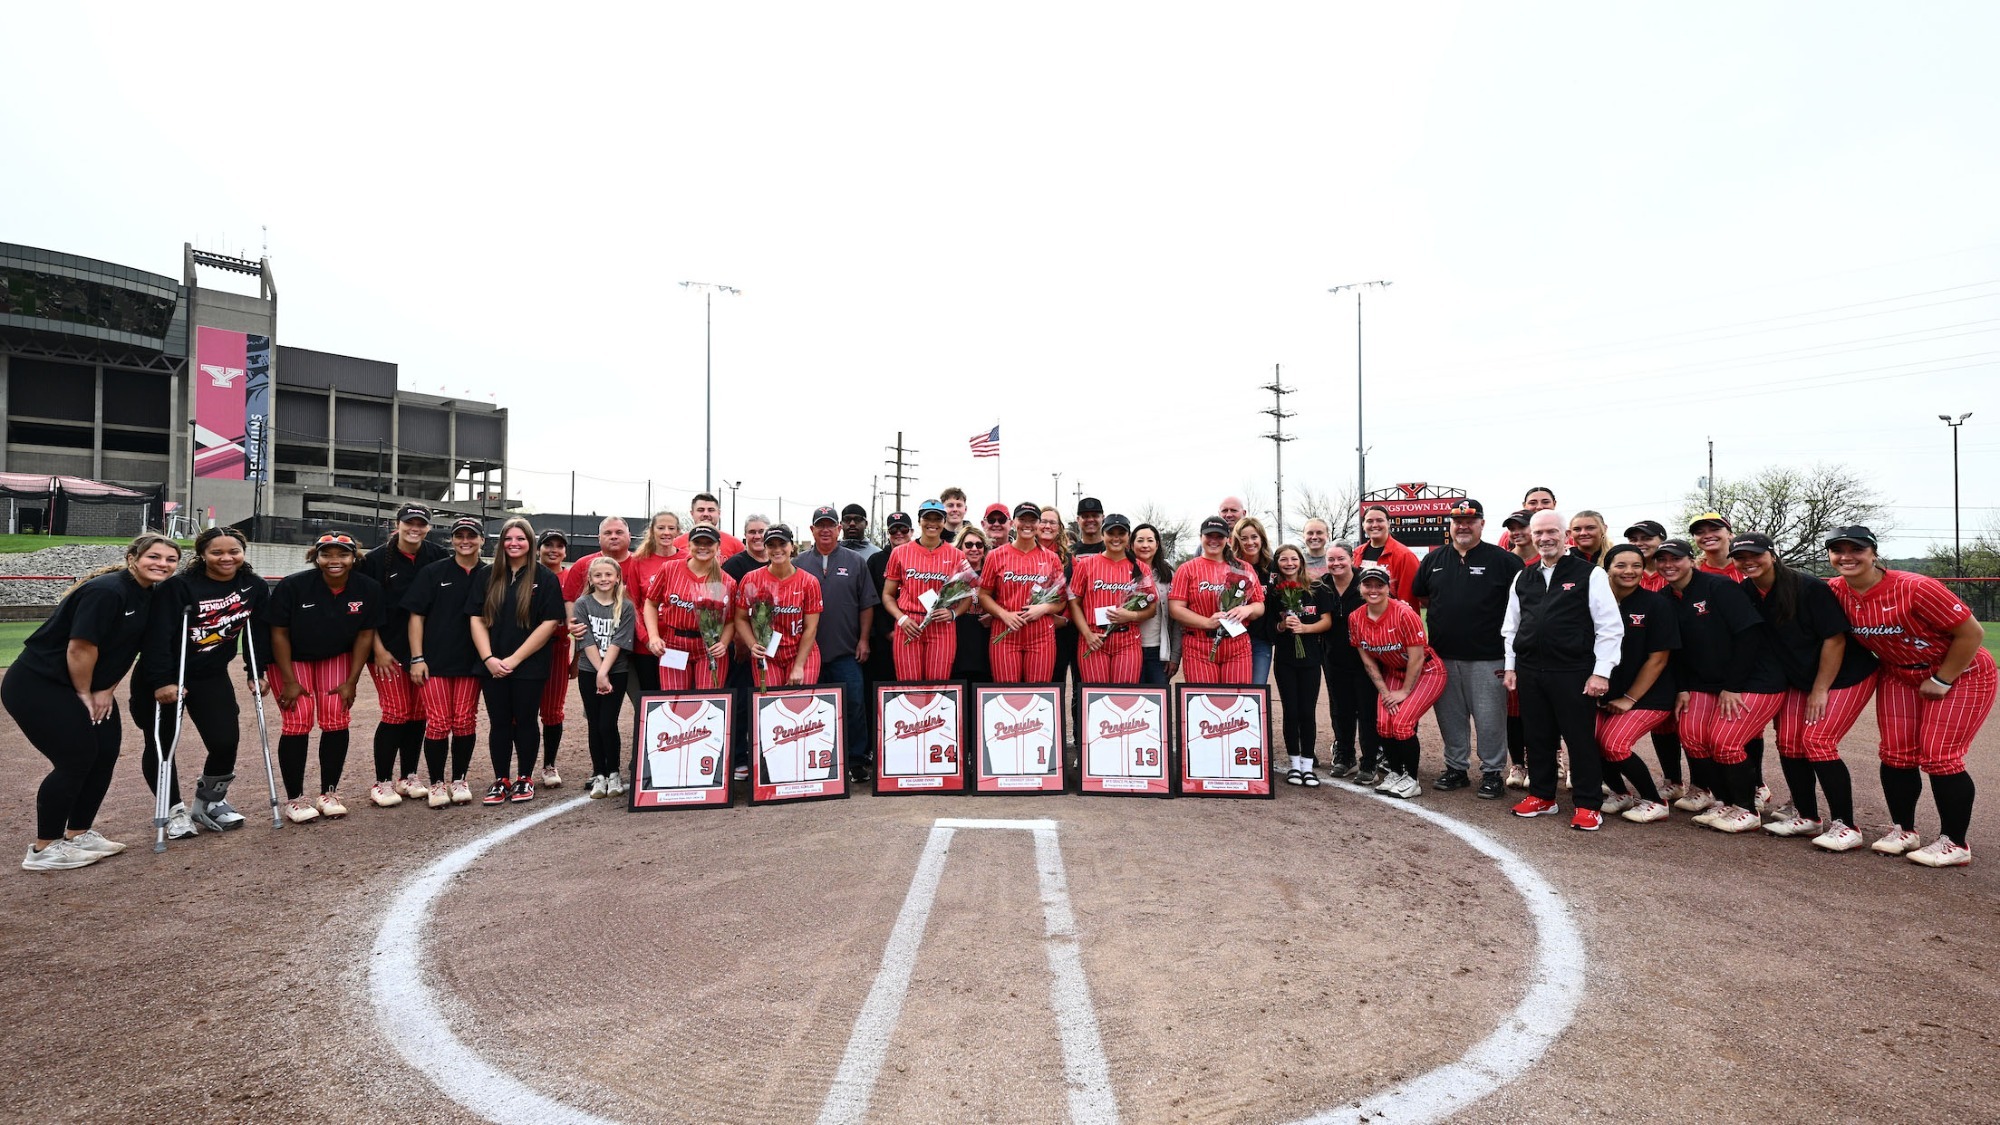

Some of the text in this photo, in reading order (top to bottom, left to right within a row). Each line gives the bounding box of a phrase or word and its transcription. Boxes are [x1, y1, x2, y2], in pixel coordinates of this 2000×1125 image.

[201, 364, 244, 389] Y
[1396, 482, 1427, 500] Y
[199, 594, 241, 612] PENGUINS
[348, 601, 363, 612] Y
[669, 594, 695, 613] Peng
[1693, 600, 1706, 613] Y
[1629, 613, 1645, 625] Y
[1852, 624, 1904, 639] nguins
[1360, 640, 1402, 655] Penguins
[773, 720, 825, 742] Penguins
[895, 714, 946, 735] Penguins
[994, 717, 1044, 737] Penguins
[1100, 717, 1150, 737] Penguins
[1199, 716, 1249, 737] Penguins
[657, 726, 712, 748] Penguins
[808, 750, 833, 769] 12
[930, 745, 957, 763] 24
[1037, 746, 1046, 764] 1
[1135, 748, 1159, 766] 13
[1235, 747, 1261, 765] 29
[700, 756, 714, 775] 9
